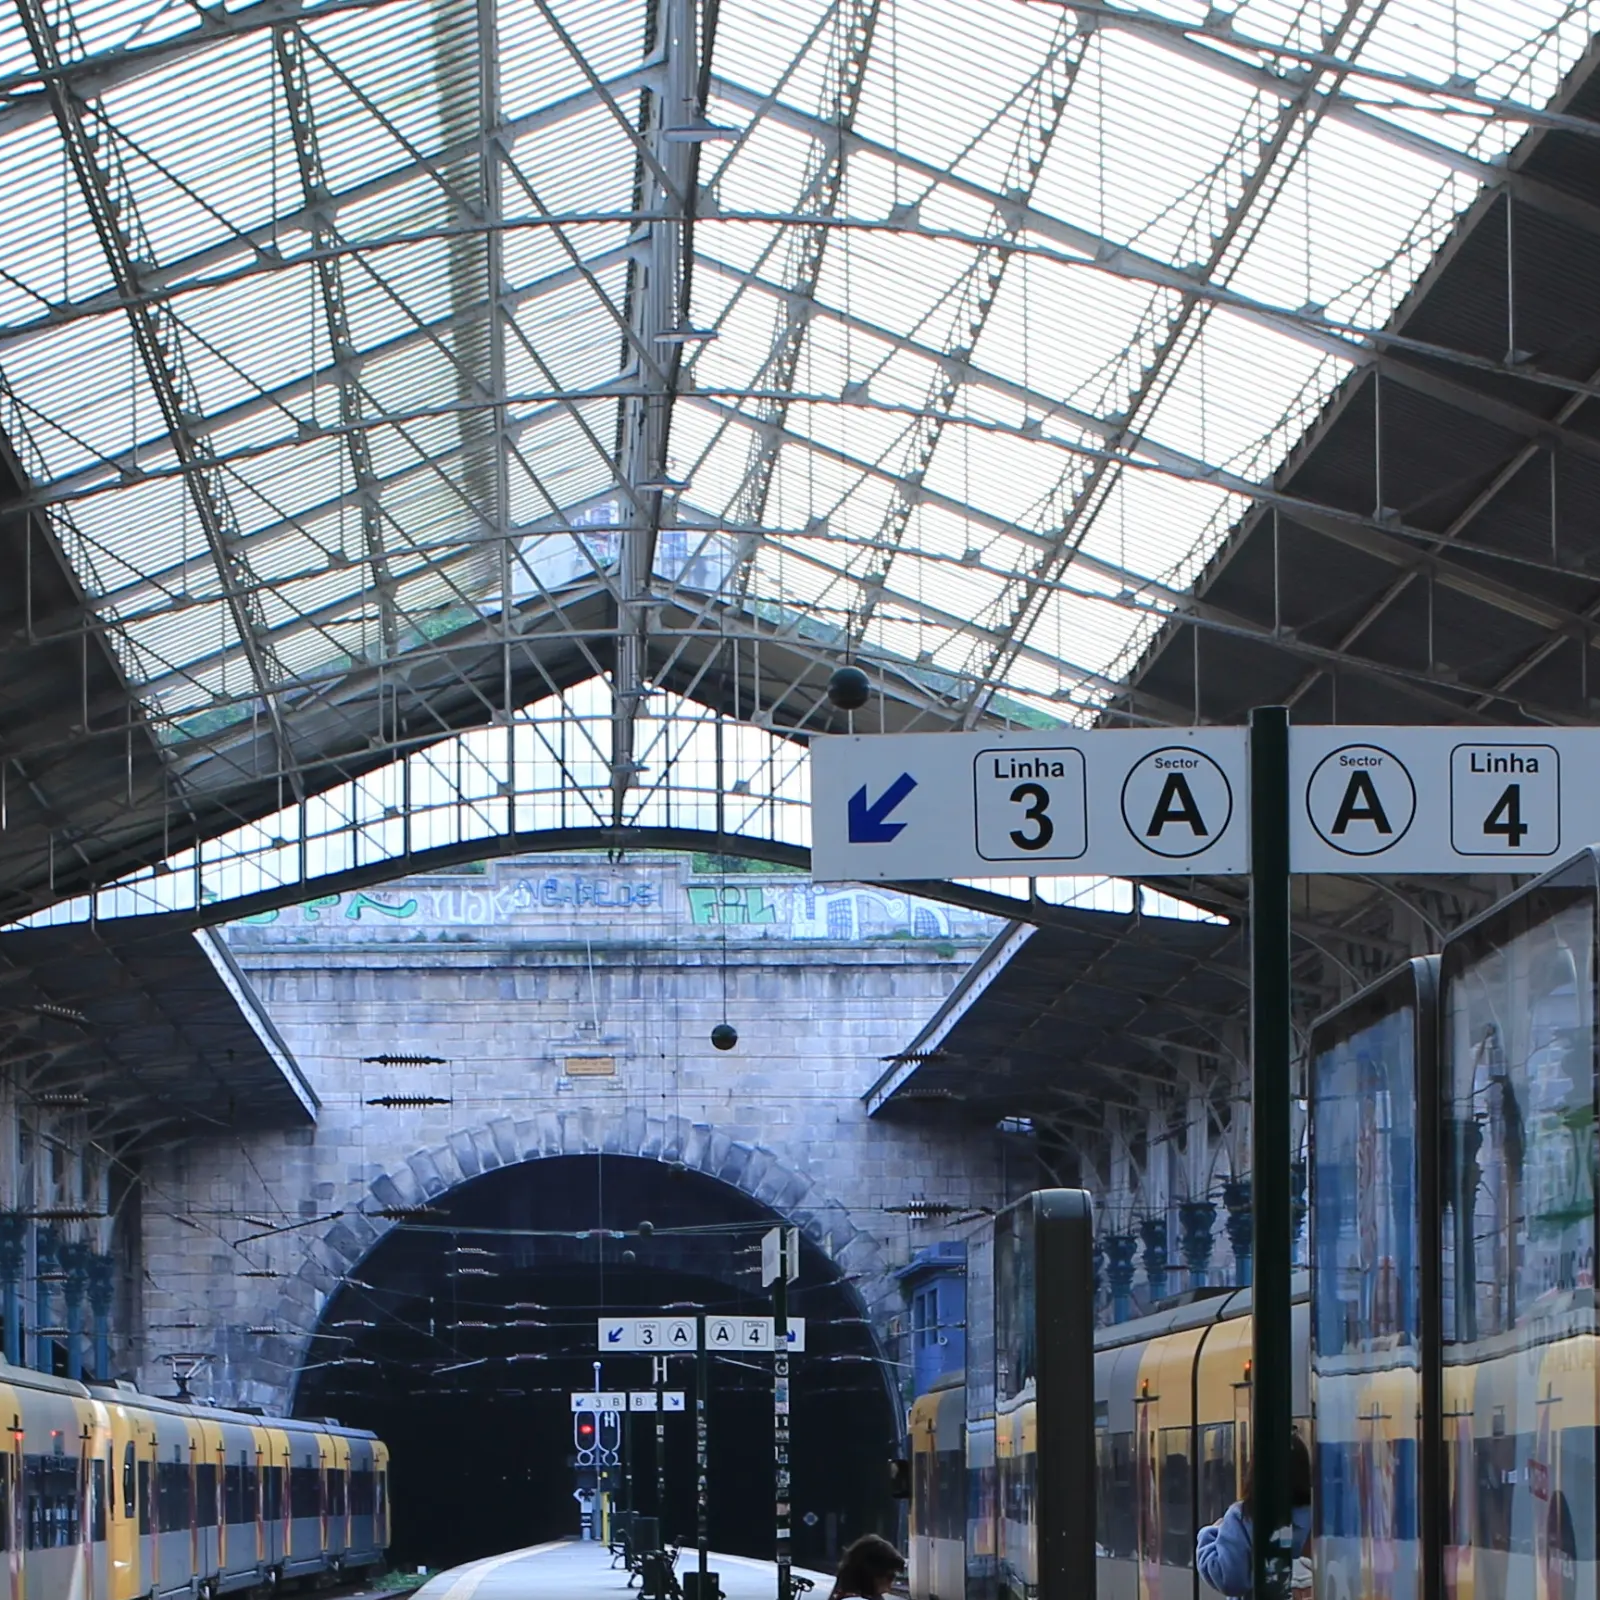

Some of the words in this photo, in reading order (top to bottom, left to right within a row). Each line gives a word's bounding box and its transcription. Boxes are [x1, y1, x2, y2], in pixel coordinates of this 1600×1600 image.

[994, 758, 1065, 779] Linha
[1154, 757, 1199, 771] Sector
[1339, 755, 1383, 768] Sector
[1470, 753, 1540, 774] Linha
[1146, 773, 1208, 836] A
[1331, 771, 1393, 834] A
[1009, 783, 1054, 850] 3
[1484, 784, 1528, 846] 4
[643, 1330, 653, 1345] 3
[674, 1327, 687, 1342] A
[716, 1327, 729, 1341] A
[749, 1329, 760, 1343] 4
[596, 1399, 601, 1408] 3
[613, 1398, 620, 1406] B
[636, 1398, 643, 1406] B
